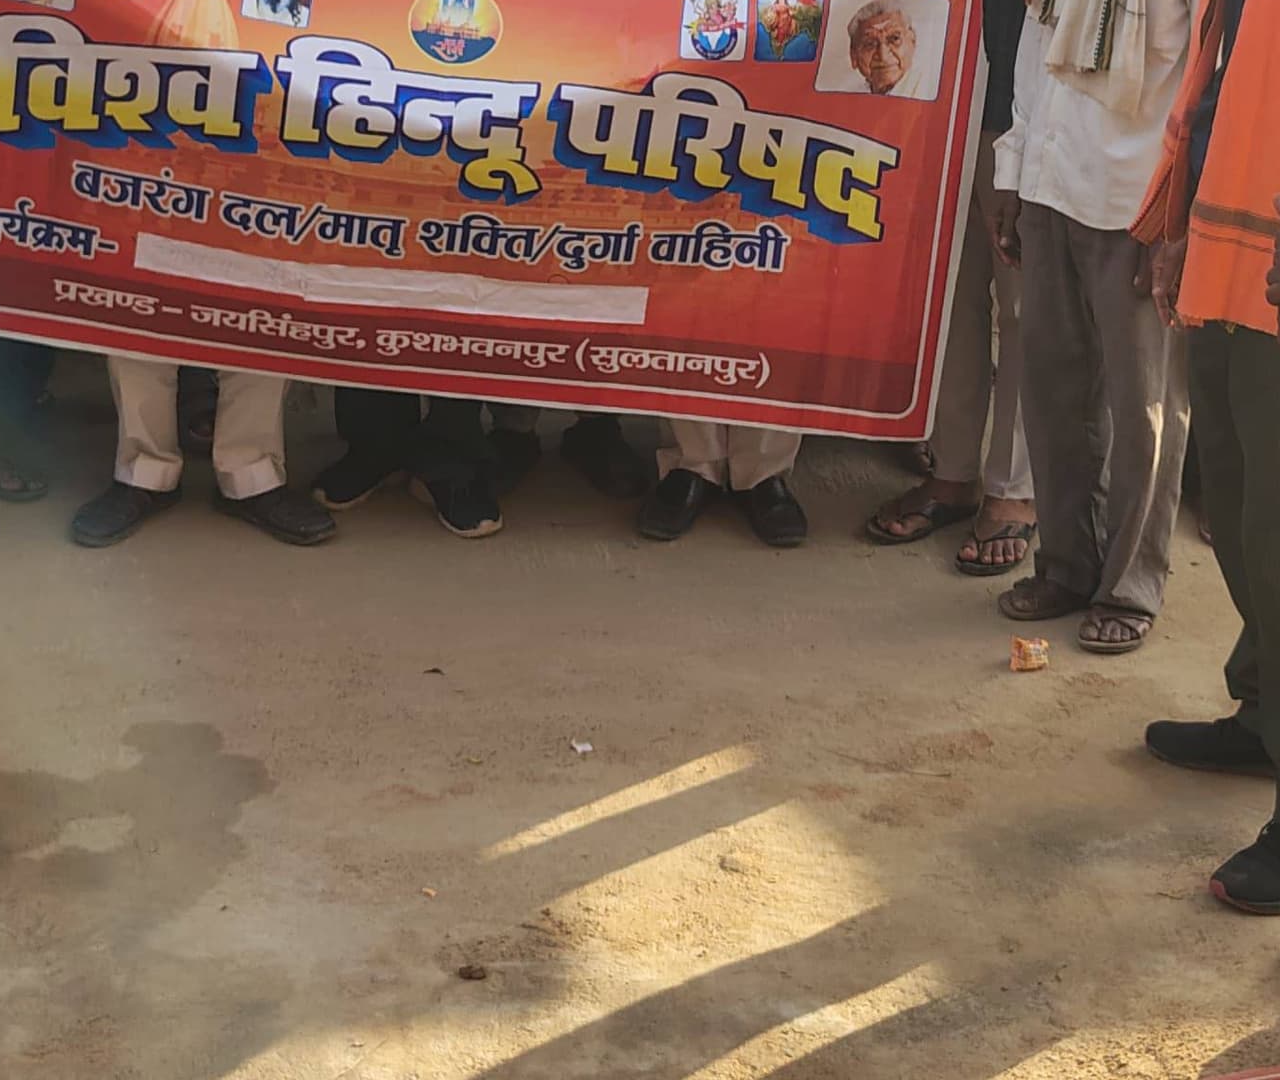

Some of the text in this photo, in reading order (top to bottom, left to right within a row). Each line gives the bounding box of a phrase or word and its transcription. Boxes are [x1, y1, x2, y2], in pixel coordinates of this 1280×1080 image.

[275, 34, 542, 195] हिन्दू
[557, 71, 901, 242] परिषद
[74, 161, 786, 271] बजरंग दल/मातृ शक्ति/दुर्गा वाहिनी
[53, 278, 157, 316] प्रखण्ड
[190, 303, 366, 350] जयसिंहपुर,
[376, 328, 569, 368] कुशभवनपुर
[576, 338, 771, 388] (सुलतानपुर)
